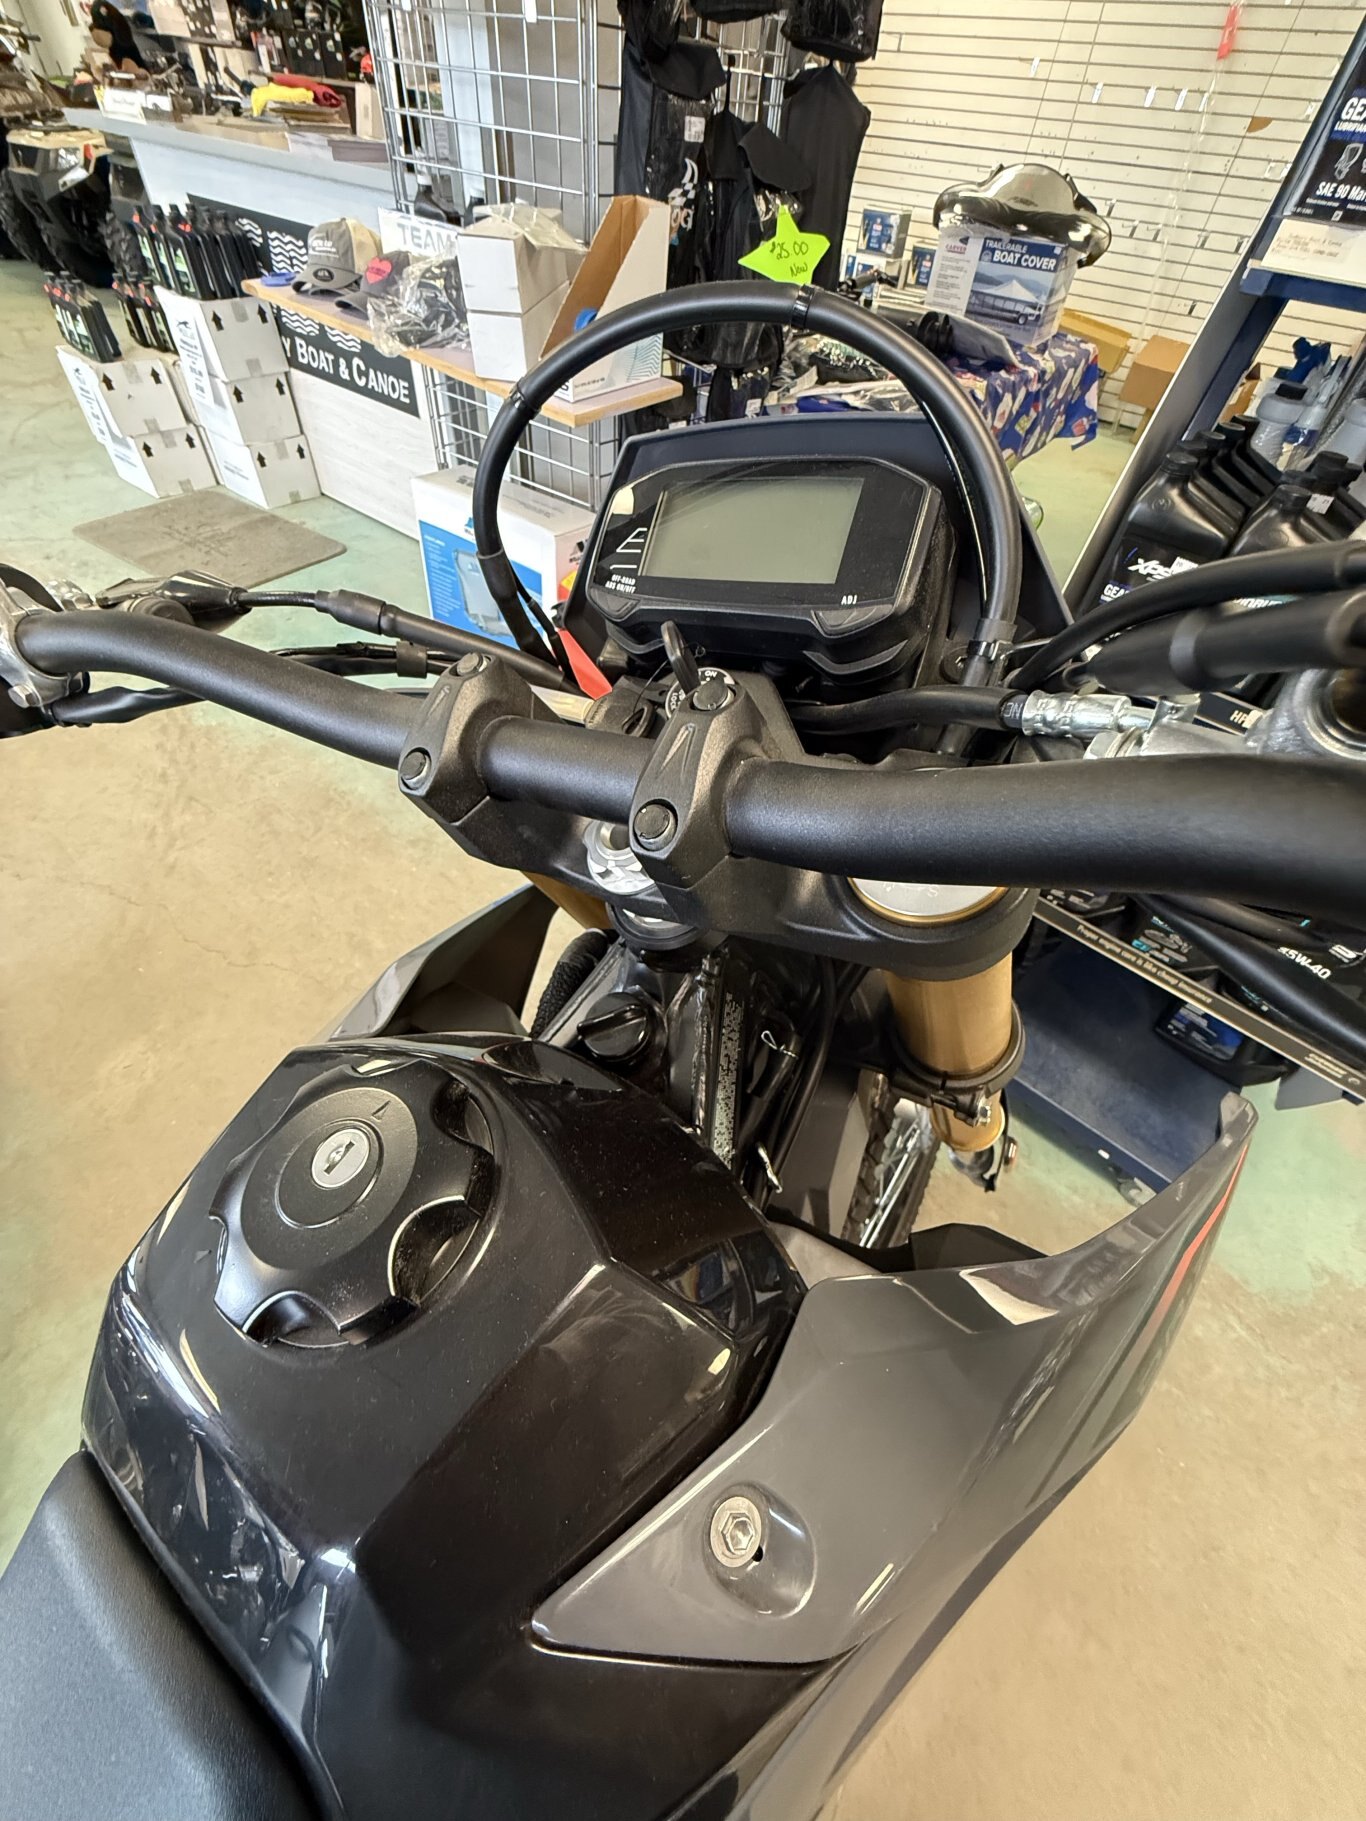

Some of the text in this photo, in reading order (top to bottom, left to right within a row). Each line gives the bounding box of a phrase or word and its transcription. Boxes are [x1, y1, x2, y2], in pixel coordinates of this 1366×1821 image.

[1316, 181, 1337, 197] SAE
[1335, 184, 1350, 199] 90
[985, 240, 1028, 254] TRAILERABLE
[993, 250, 1057, 271] BOAT COVER
[295, 336, 335, 374] BOAT
[339, 357, 351, 381] &
[352, 356, 410, 404] CANOE
[605, 580, 616, 590] ABS
[841, 594, 858, 605] ADJ
[704, 670, 718, 678] ON
